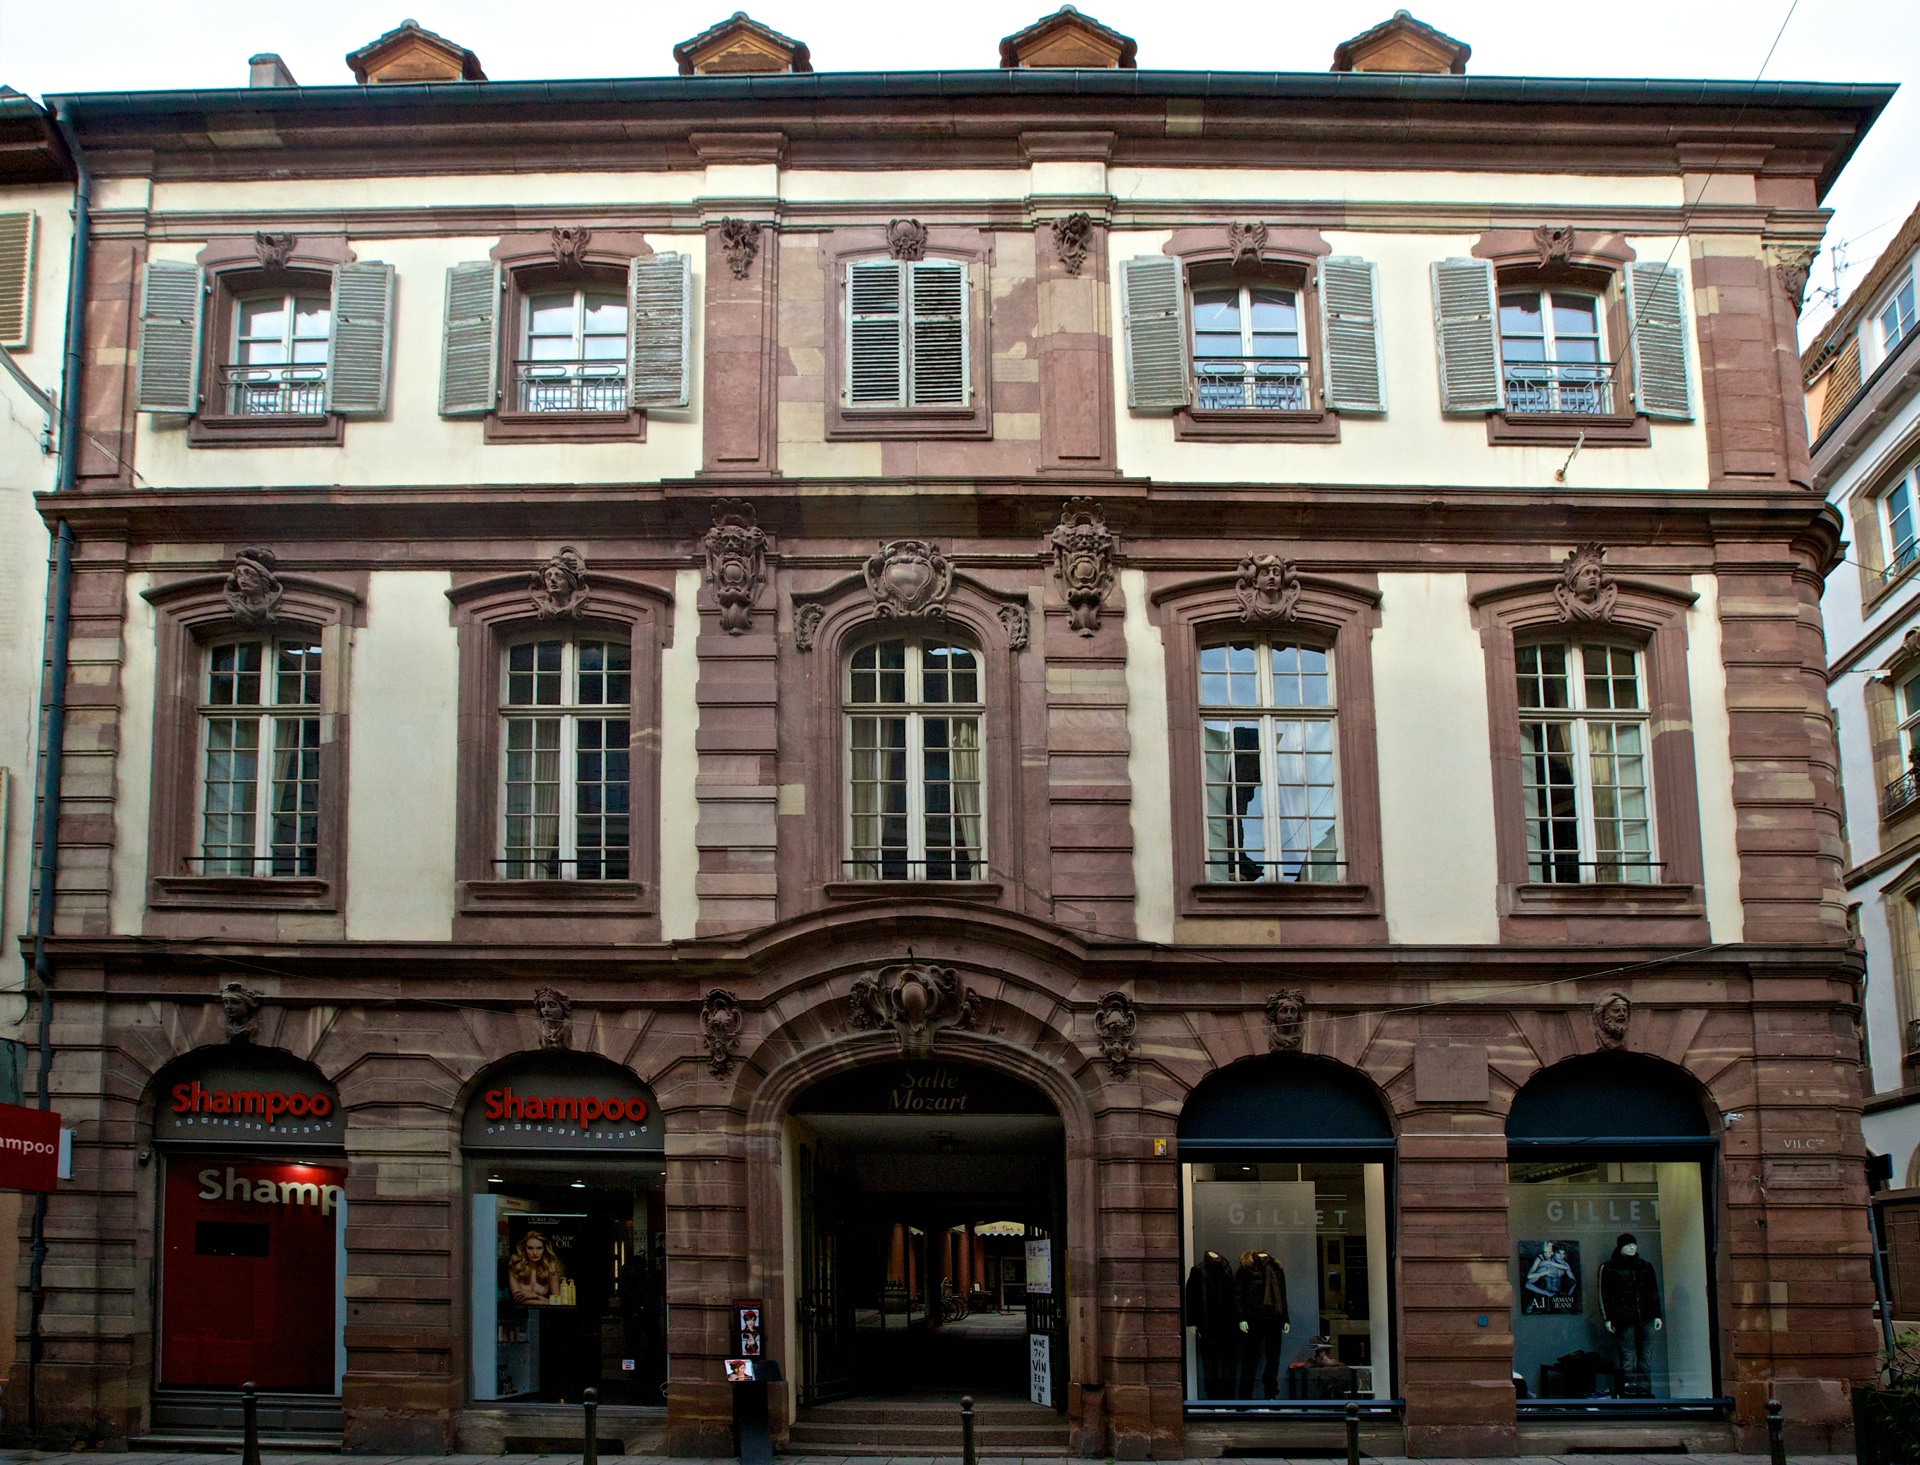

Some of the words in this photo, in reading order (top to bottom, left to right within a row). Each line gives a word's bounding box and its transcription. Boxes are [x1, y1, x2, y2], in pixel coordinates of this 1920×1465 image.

[900, 1067, 959, 1089] Salle
[171, 1080, 333, 1124] Shampoo
[483, 1086, 648, 1130] Shampoo
[887, 1088, 969, 1110] Mozart
[1228, 1202, 1348, 1225] GILLET
[1546, 1200, 1660, 1222] GILLET
[1531, 1297, 1545, 1308] AJ
